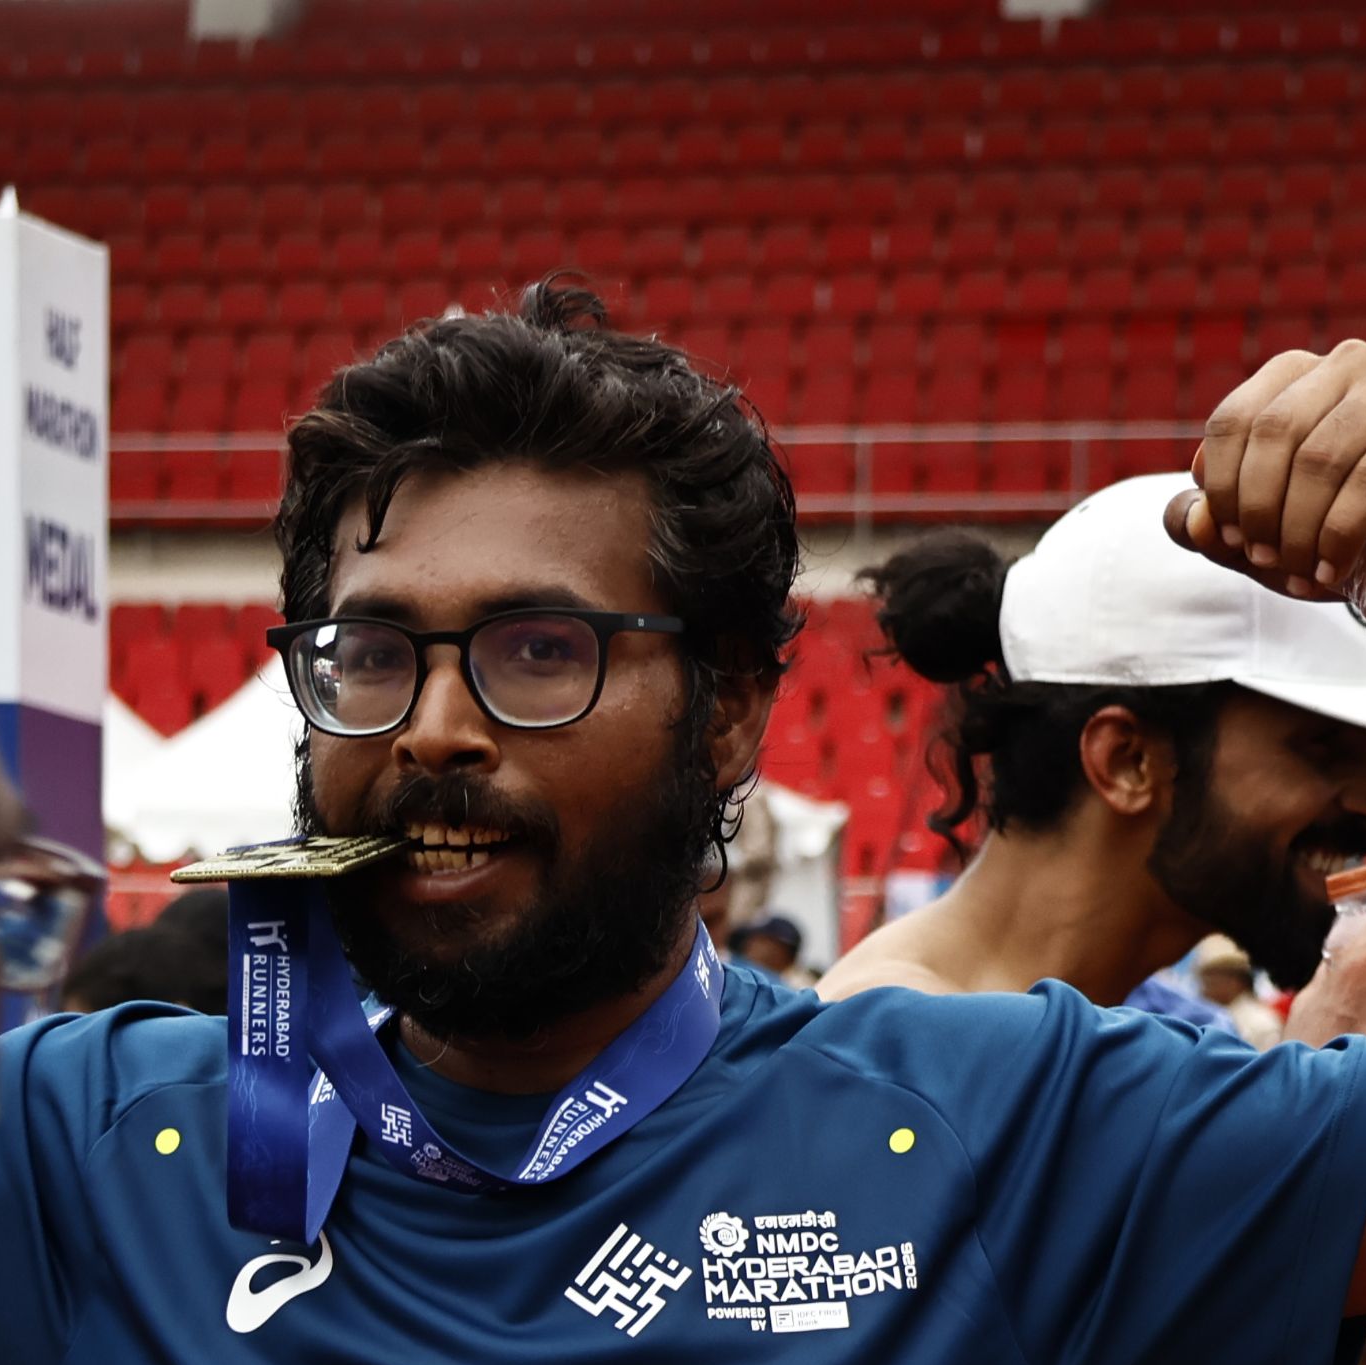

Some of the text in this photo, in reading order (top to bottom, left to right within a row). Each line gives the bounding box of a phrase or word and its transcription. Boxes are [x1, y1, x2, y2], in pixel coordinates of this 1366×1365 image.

[251, 954, 267, 1057] RUNNERS
[275, 955, 291, 1058] HYDERABAD
[756, 1232, 839, 1255] NMDC
[702, 1246, 899, 1280] HYDERABAD
[704, 1266, 903, 1303] MARATHON
[707, 1307, 766, 1320] POWERED
[751, 1320, 767, 1332] BY
